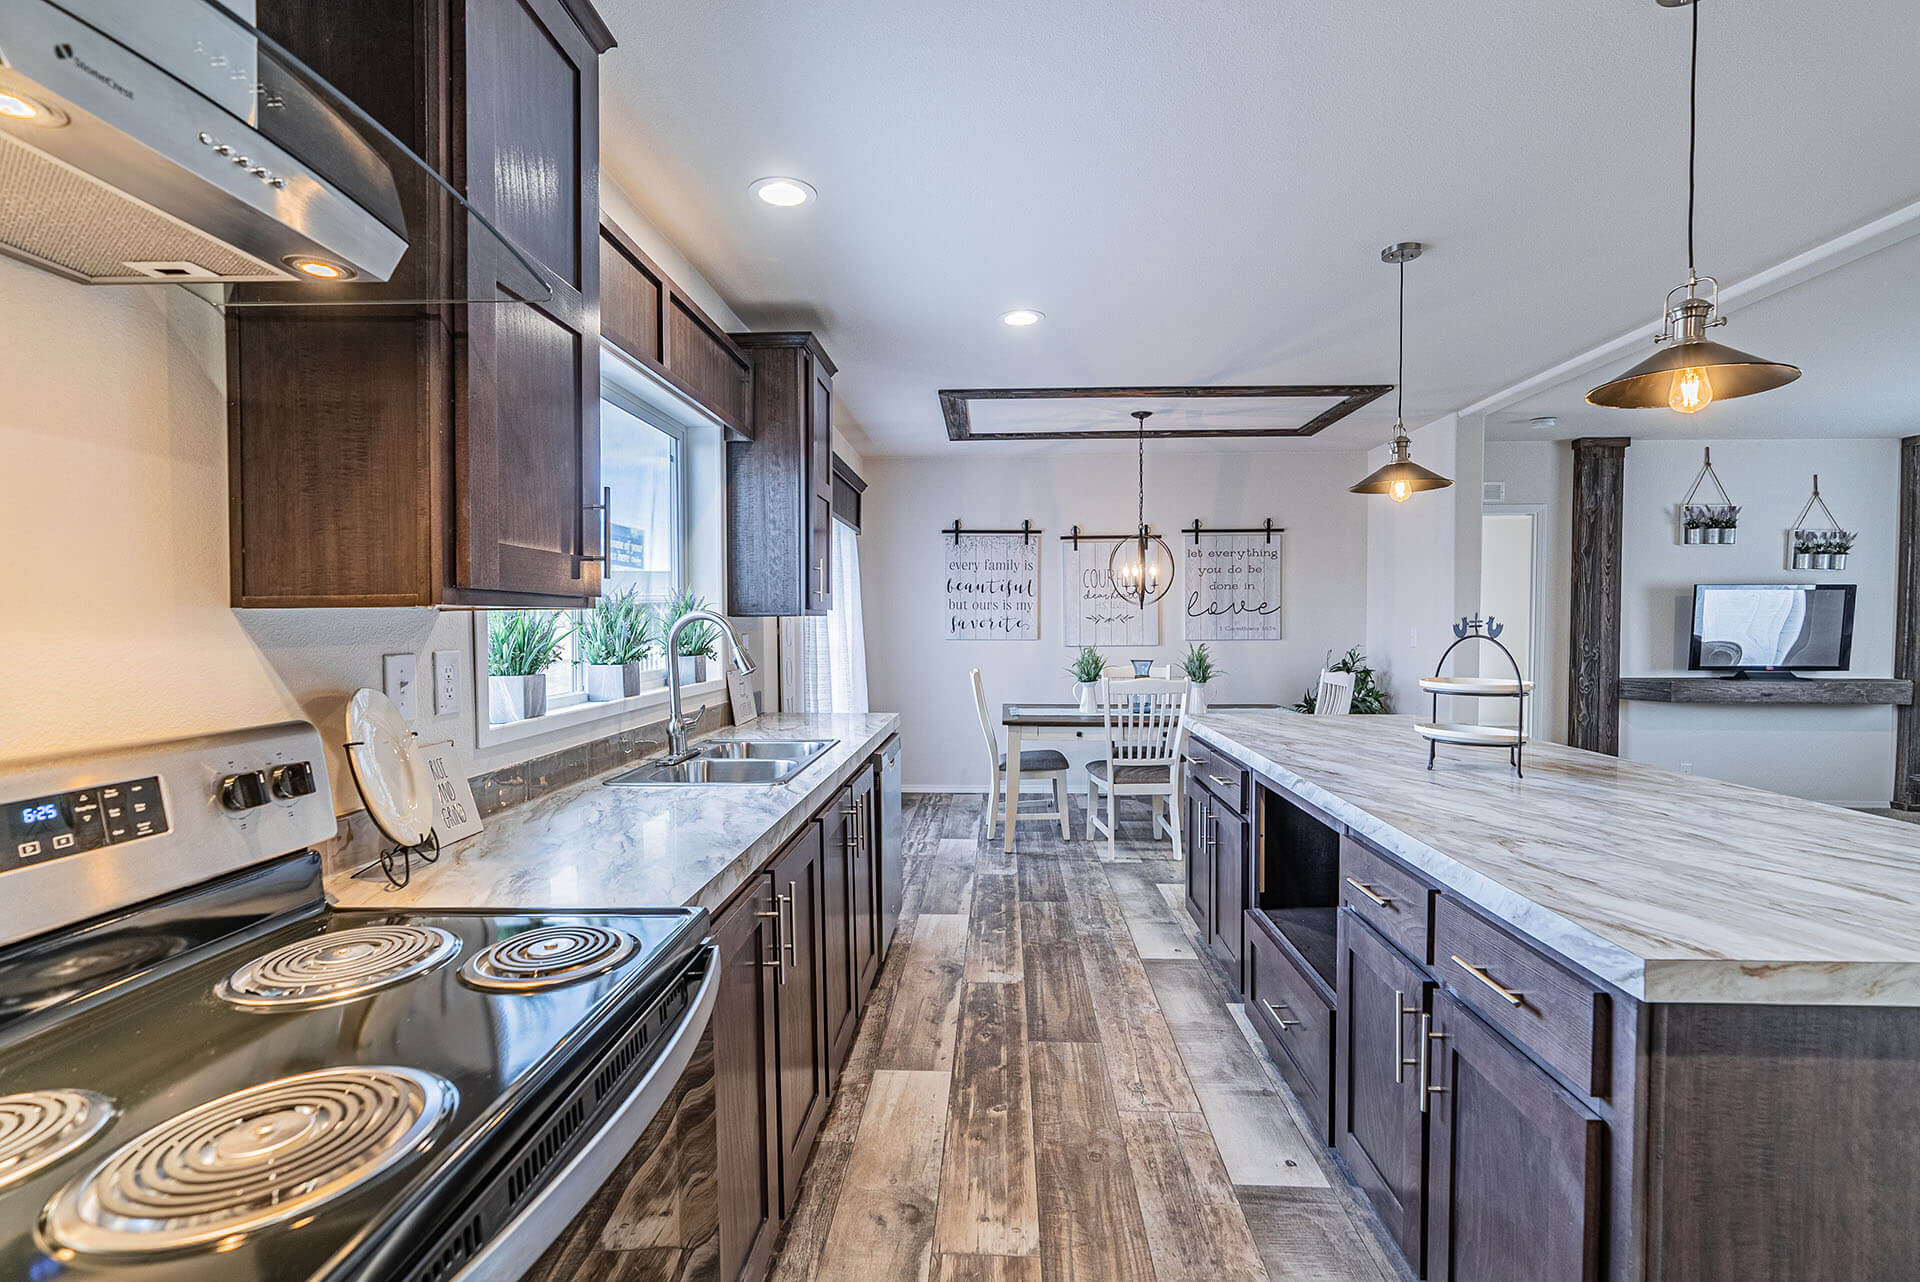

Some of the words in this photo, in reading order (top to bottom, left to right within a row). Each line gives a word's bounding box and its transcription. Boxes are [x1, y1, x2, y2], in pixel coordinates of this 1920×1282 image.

[1187, 549, 1203, 558] let
[1208, 548, 1278, 560] everything
[949, 561, 978, 573] every
[984, 559, 1020, 573] family
[1024, 559, 1034, 571] is
[1198, 566, 1222, 577] you
[1228, 565, 1242, 574] do
[1248, 565, 1263, 574] be
[946, 578, 1034, 598] beautiful
[1209, 582, 1239, 591] done
[1244, 582, 1256, 591] in
[948, 598, 967, 611] but
[972, 601, 999, 611] ours
[1003, 599, 1013, 611] is
[1016, 601, 1034, 614] my
[1187, 591, 1281, 617] love
[950, 616, 1031, 633] favorite
[22, 803, 58, 824] 6:25
